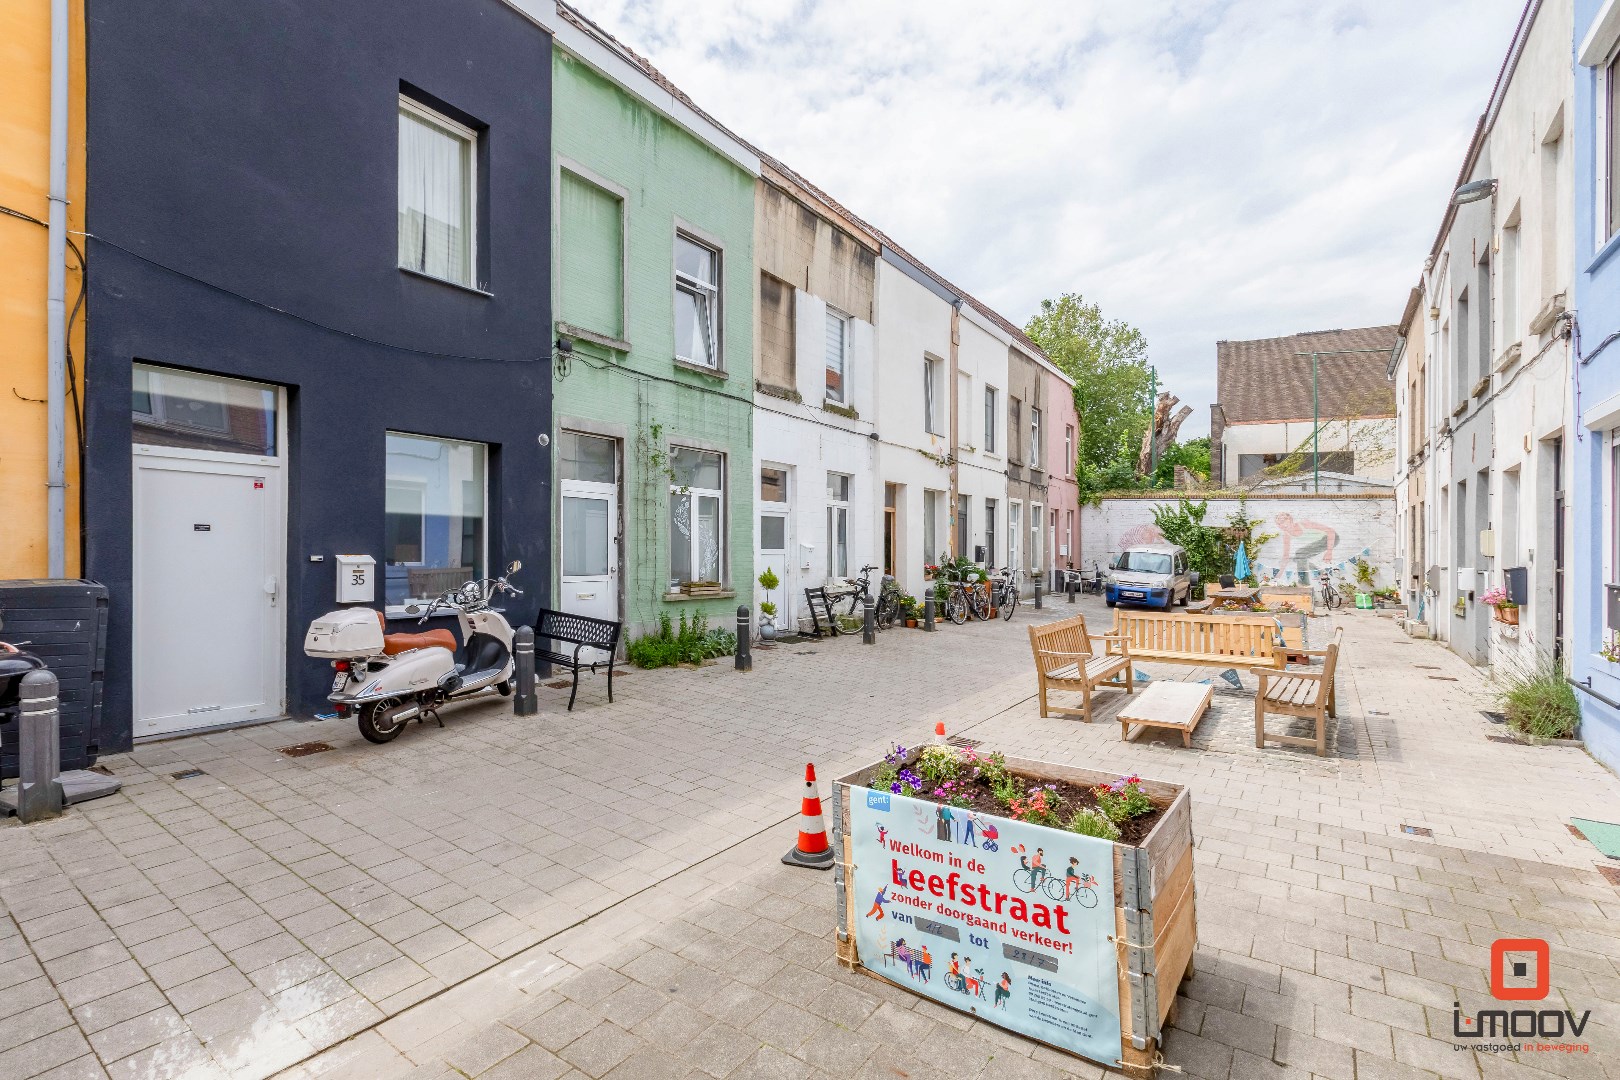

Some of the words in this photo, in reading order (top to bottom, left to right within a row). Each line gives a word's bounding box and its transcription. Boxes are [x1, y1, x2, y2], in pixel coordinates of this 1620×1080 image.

[351, 574, 365, 586] 35
[868, 795, 889, 806] gent:
[889, 838, 944, 864] Welkom
[948, 851, 962, 869] in
[967, 858, 986, 875] de
[891, 858, 1071, 935] Leefstraat
[891, 891, 933, 911] zonder
[936, 902, 1007, 935] doorgaand
[1011, 927, 1073, 955] verkeer!
[891, 910, 913, 925] van
[968, 932, 989, 950] tot
